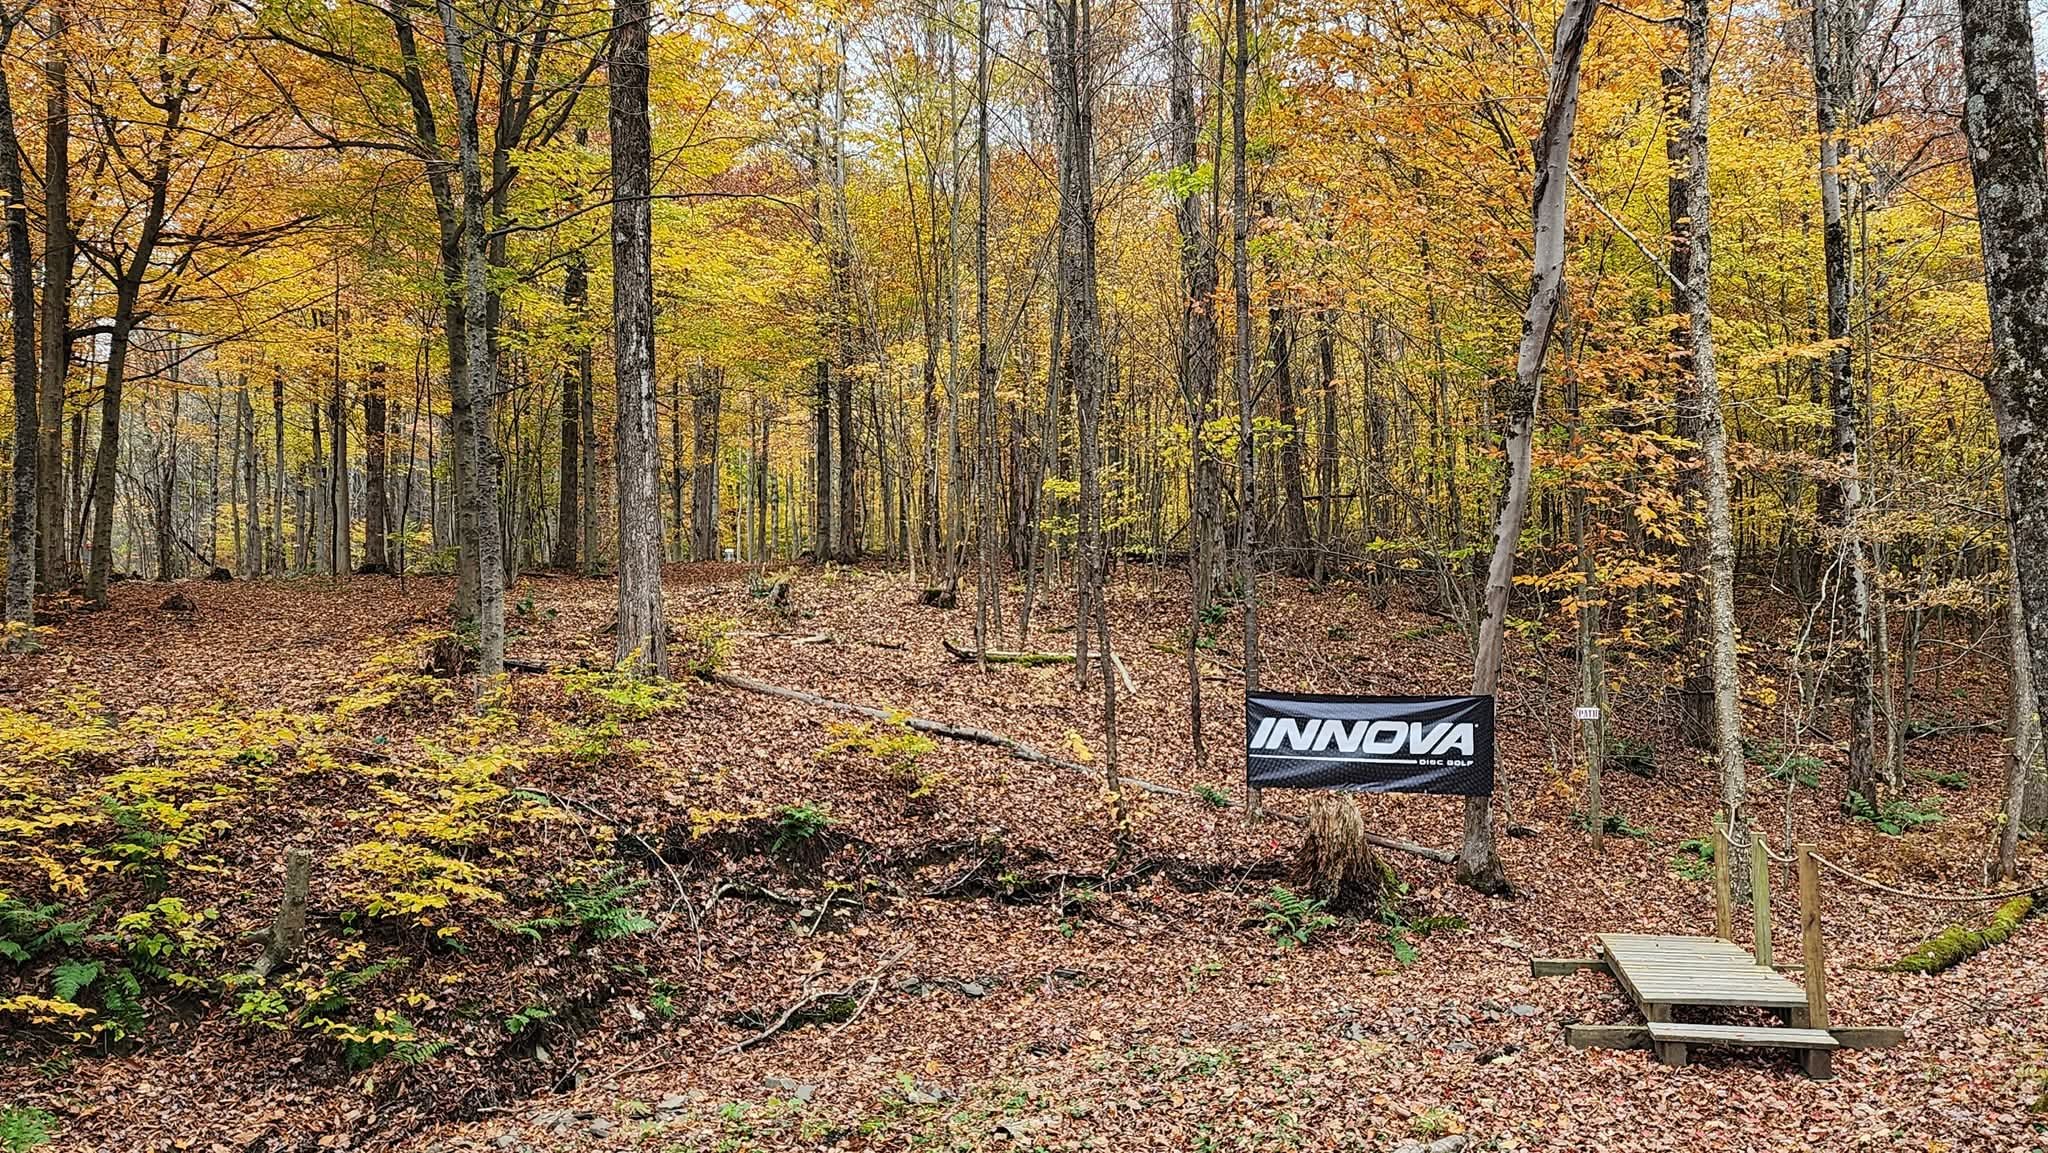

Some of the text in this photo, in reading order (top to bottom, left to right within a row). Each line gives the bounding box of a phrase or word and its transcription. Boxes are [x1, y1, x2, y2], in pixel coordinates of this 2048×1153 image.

[1578, 709, 1598, 718] PATH
[1249, 717, 1474, 756] INNOVA
[1446, 759, 1474, 767] GOLF
